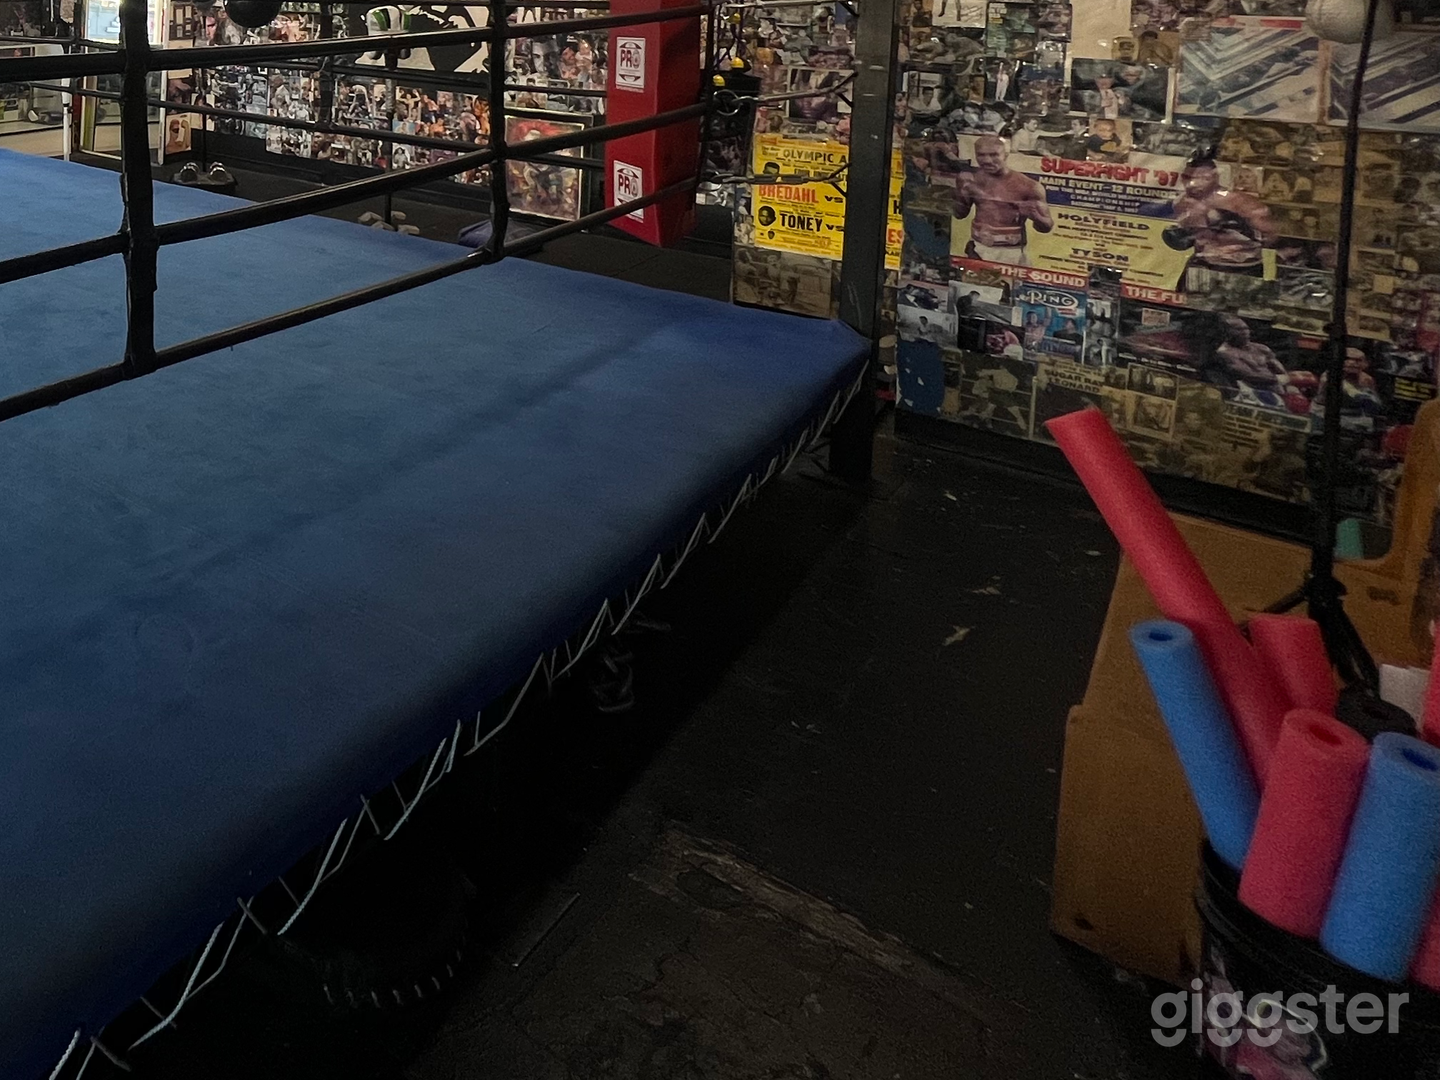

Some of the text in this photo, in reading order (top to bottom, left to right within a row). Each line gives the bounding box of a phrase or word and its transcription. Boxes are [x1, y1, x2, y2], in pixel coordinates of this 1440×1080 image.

[619, 49, 641, 70] PRO
[782, 149, 835, 164] OLYMPIC
[1040, 156, 1150, 184] SUPERFIGHT
[617, 174, 640, 198] PRO
[1039, 176, 1067, 188] MAIN
[758, 184, 820, 204] BREDAHL
[779, 213, 823, 233] TONEY
[1058, 212, 1150, 231] HOLYFIELD
[1071, 247, 1129, 262] TYSON
[1029, 270, 1087, 289] SOUND
[1026, 289, 1079, 308] RING
[1126, 285, 1157, 300] THE
